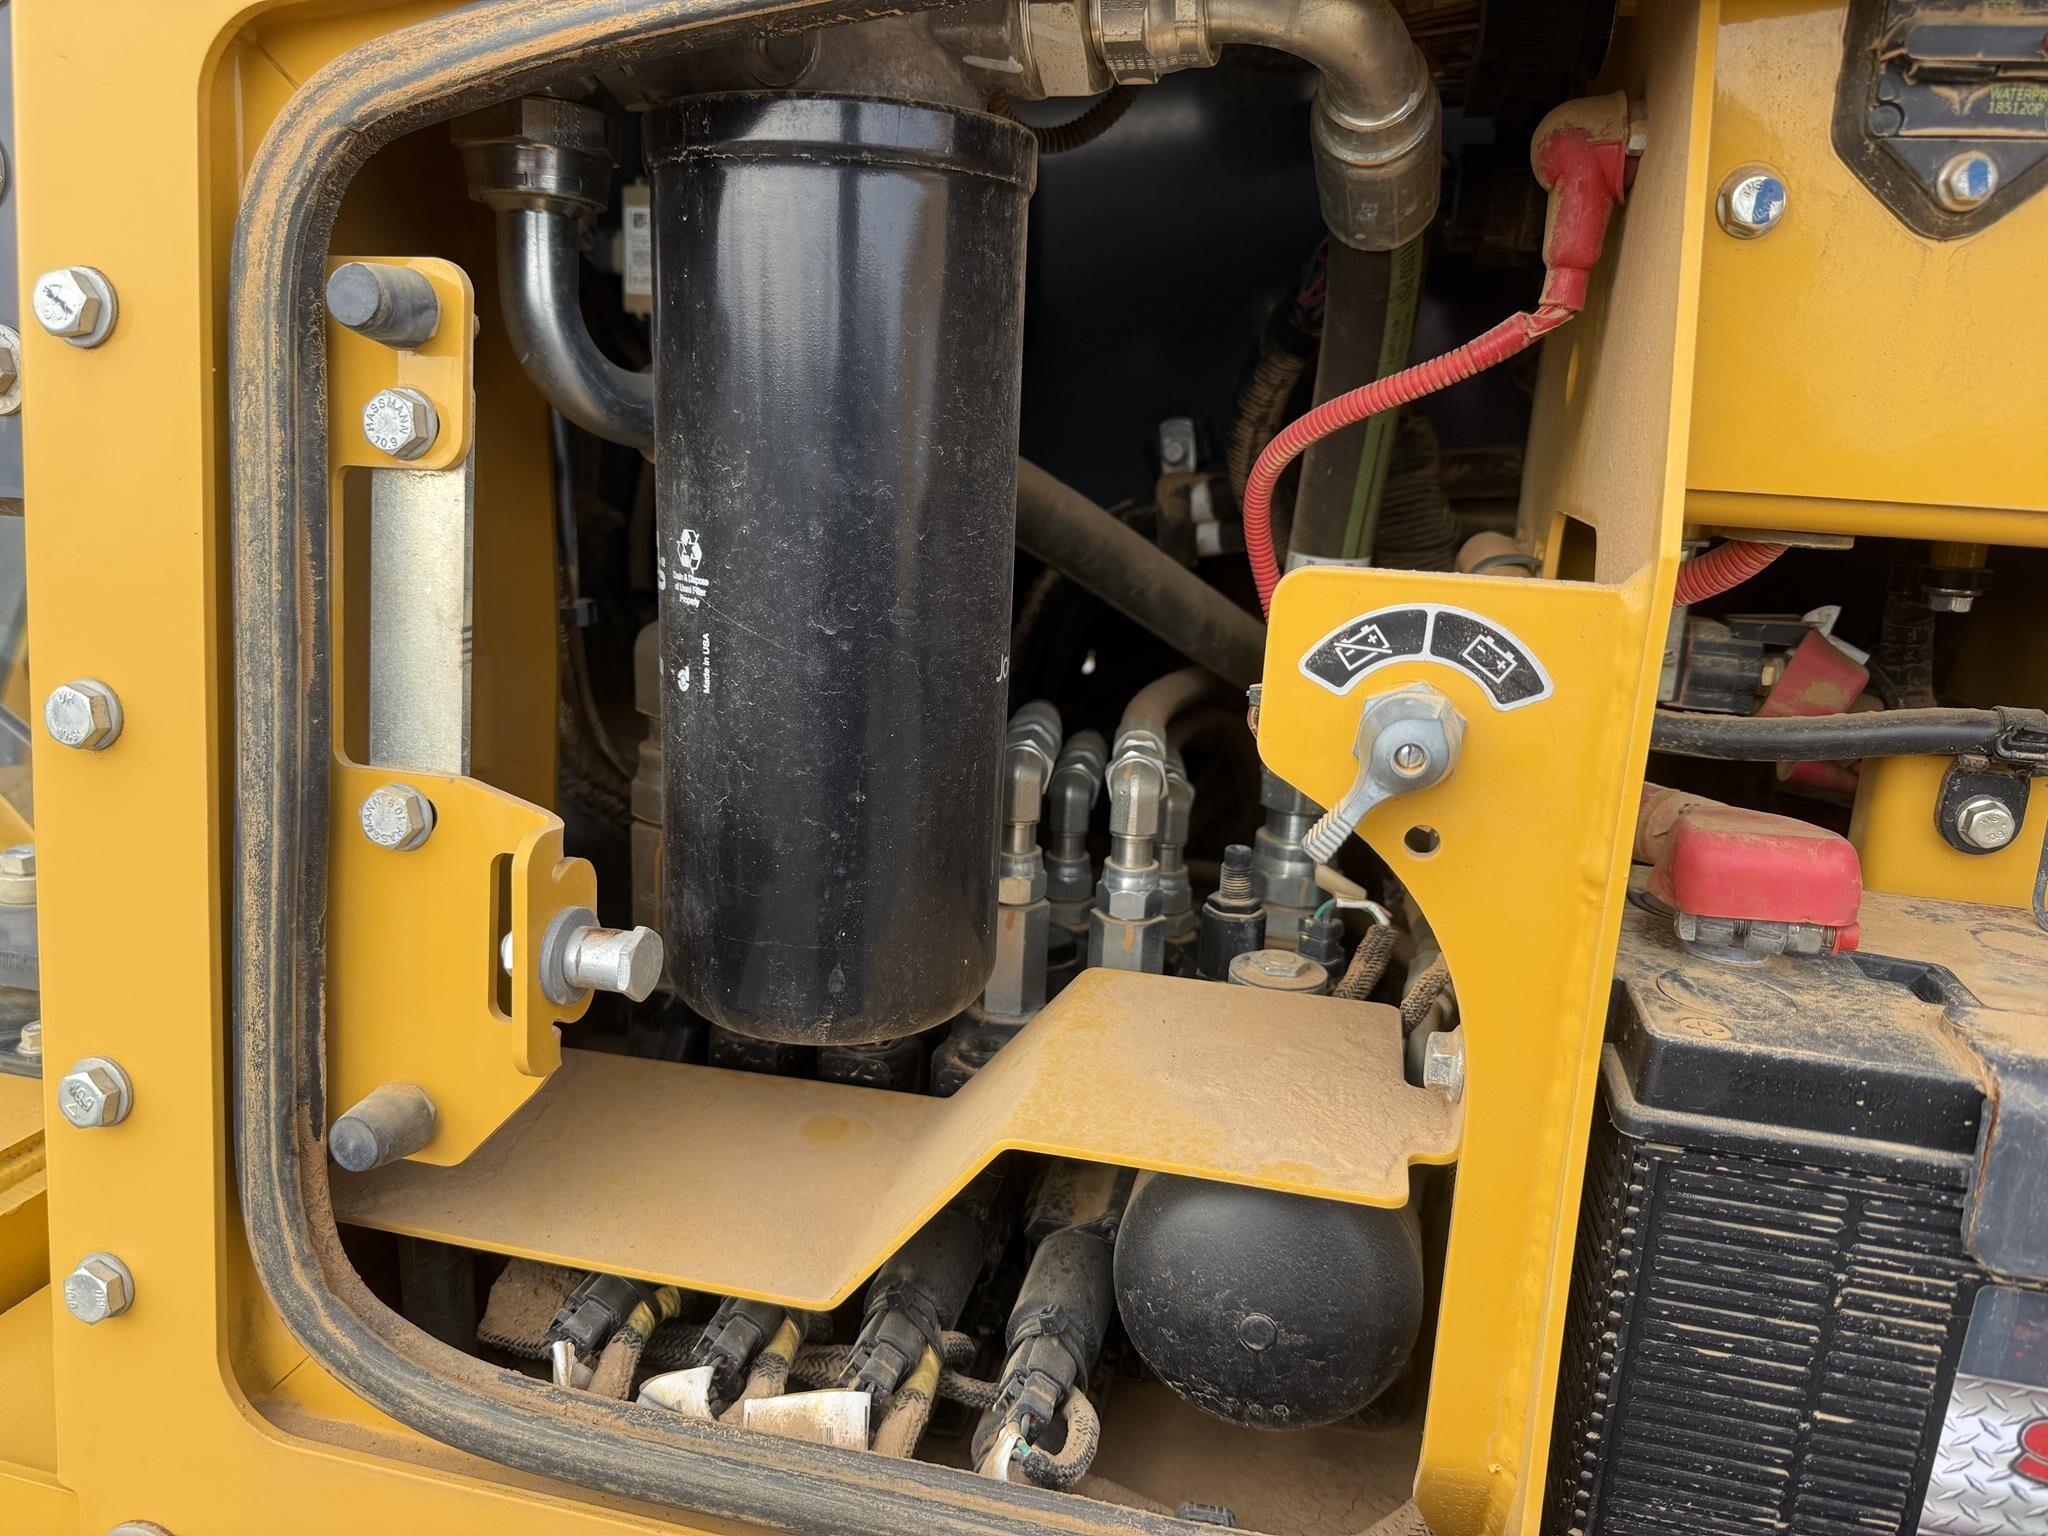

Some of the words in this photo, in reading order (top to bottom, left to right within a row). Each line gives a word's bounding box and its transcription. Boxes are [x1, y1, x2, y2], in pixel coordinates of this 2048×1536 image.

[365, 397, 409, 435] HASSMANN
[702, 632, 710, 655] USA
[702, 667, 710, 693] Made
